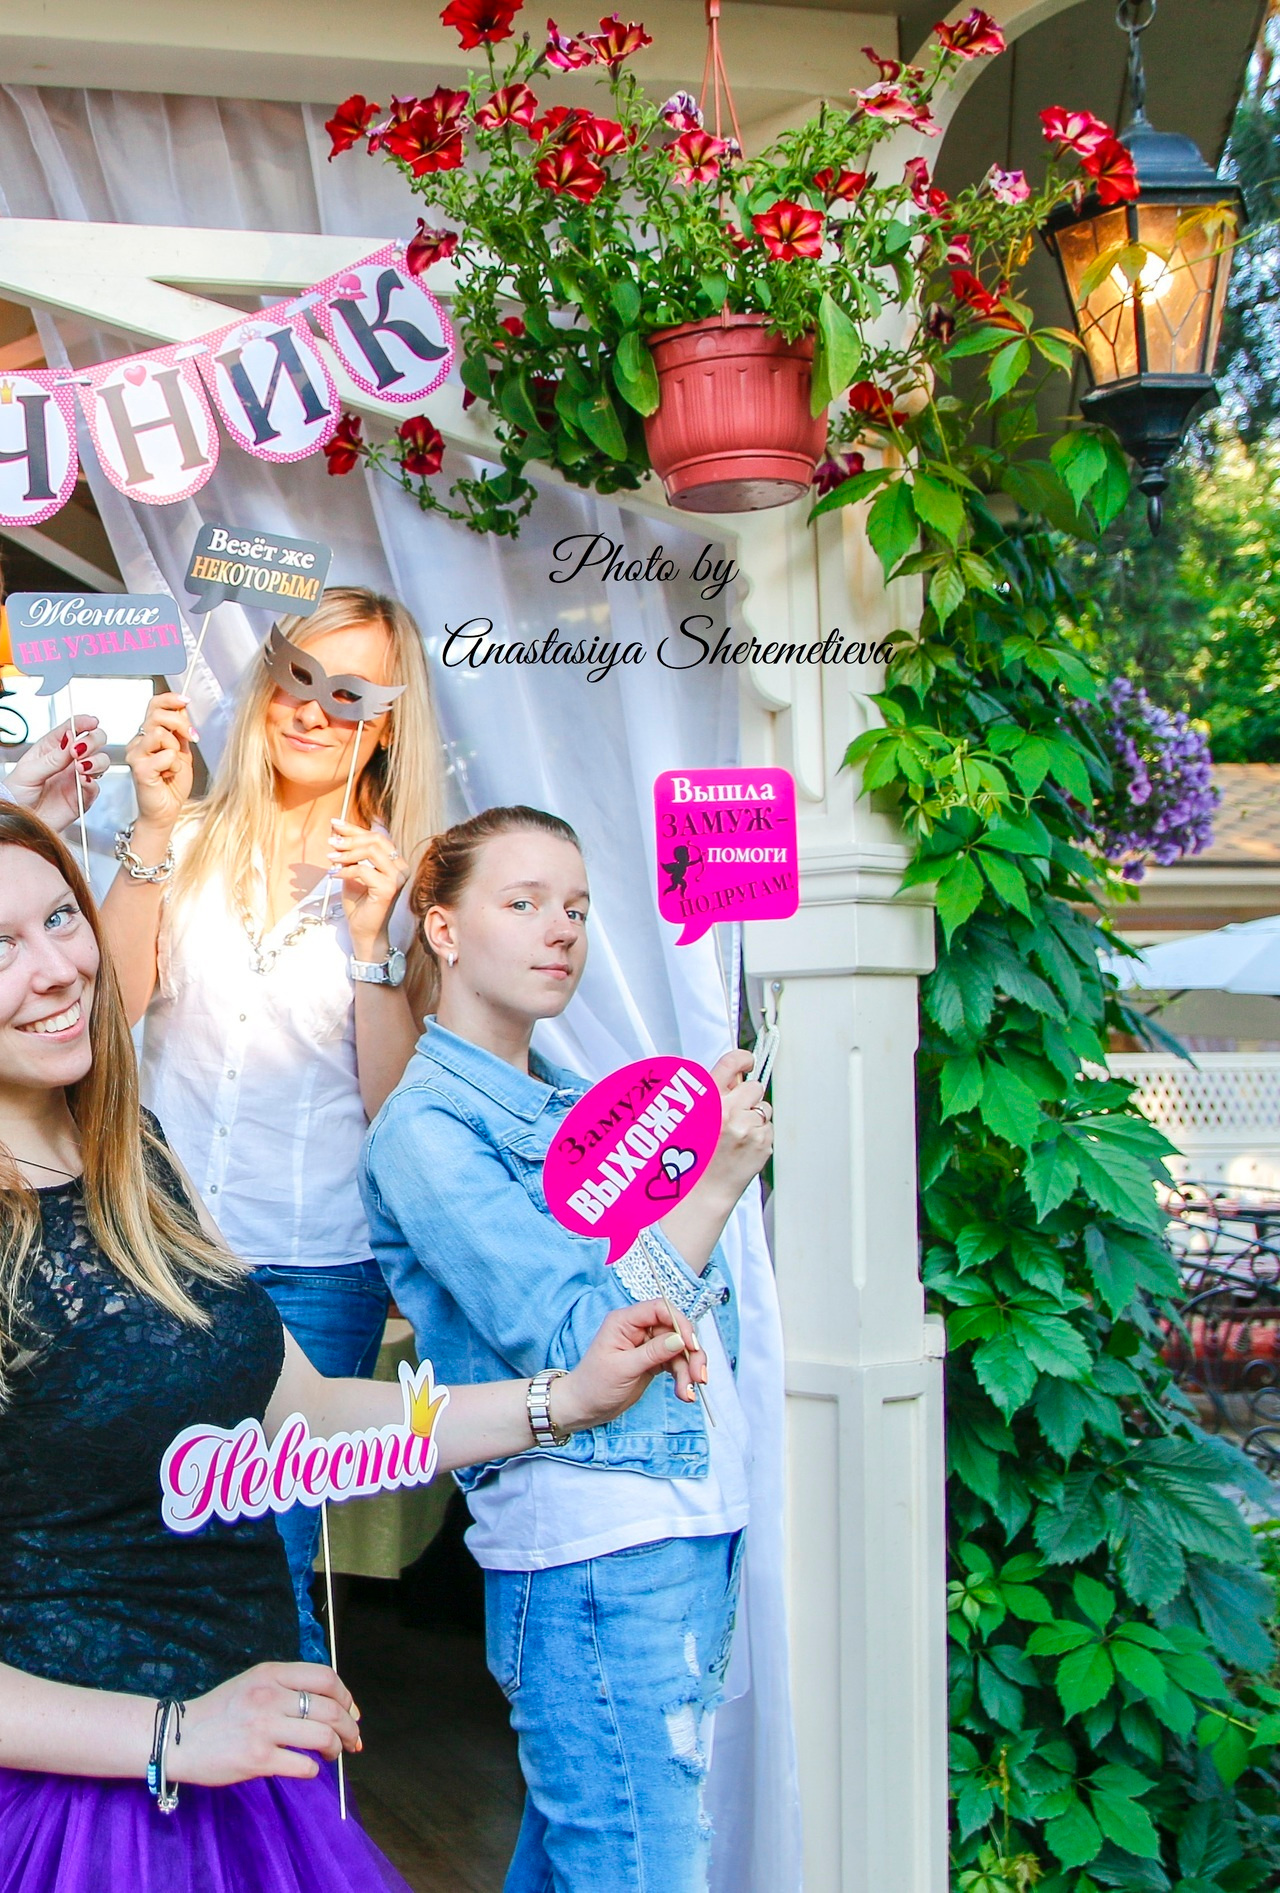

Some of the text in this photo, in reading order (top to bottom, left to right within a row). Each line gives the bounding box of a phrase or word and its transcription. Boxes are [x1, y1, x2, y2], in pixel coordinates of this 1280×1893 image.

[207, 527, 316, 570] Везёт же
[190, 555, 320, 601] НЕКОТОРЫМ!
[19, 597, 160, 627] Жених
[17, 623, 182, 665] НЕ УЗНАЕТ!
[671, 777, 776, 804] Вышла
[679, 872, 795, 918] ПОДРУГАМ!
[558, 1069, 663, 1165] Замуж
[565, 1066, 708, 1226] ВЫХОЖУ!
[168, 1421, 436, 1520] Невеста
